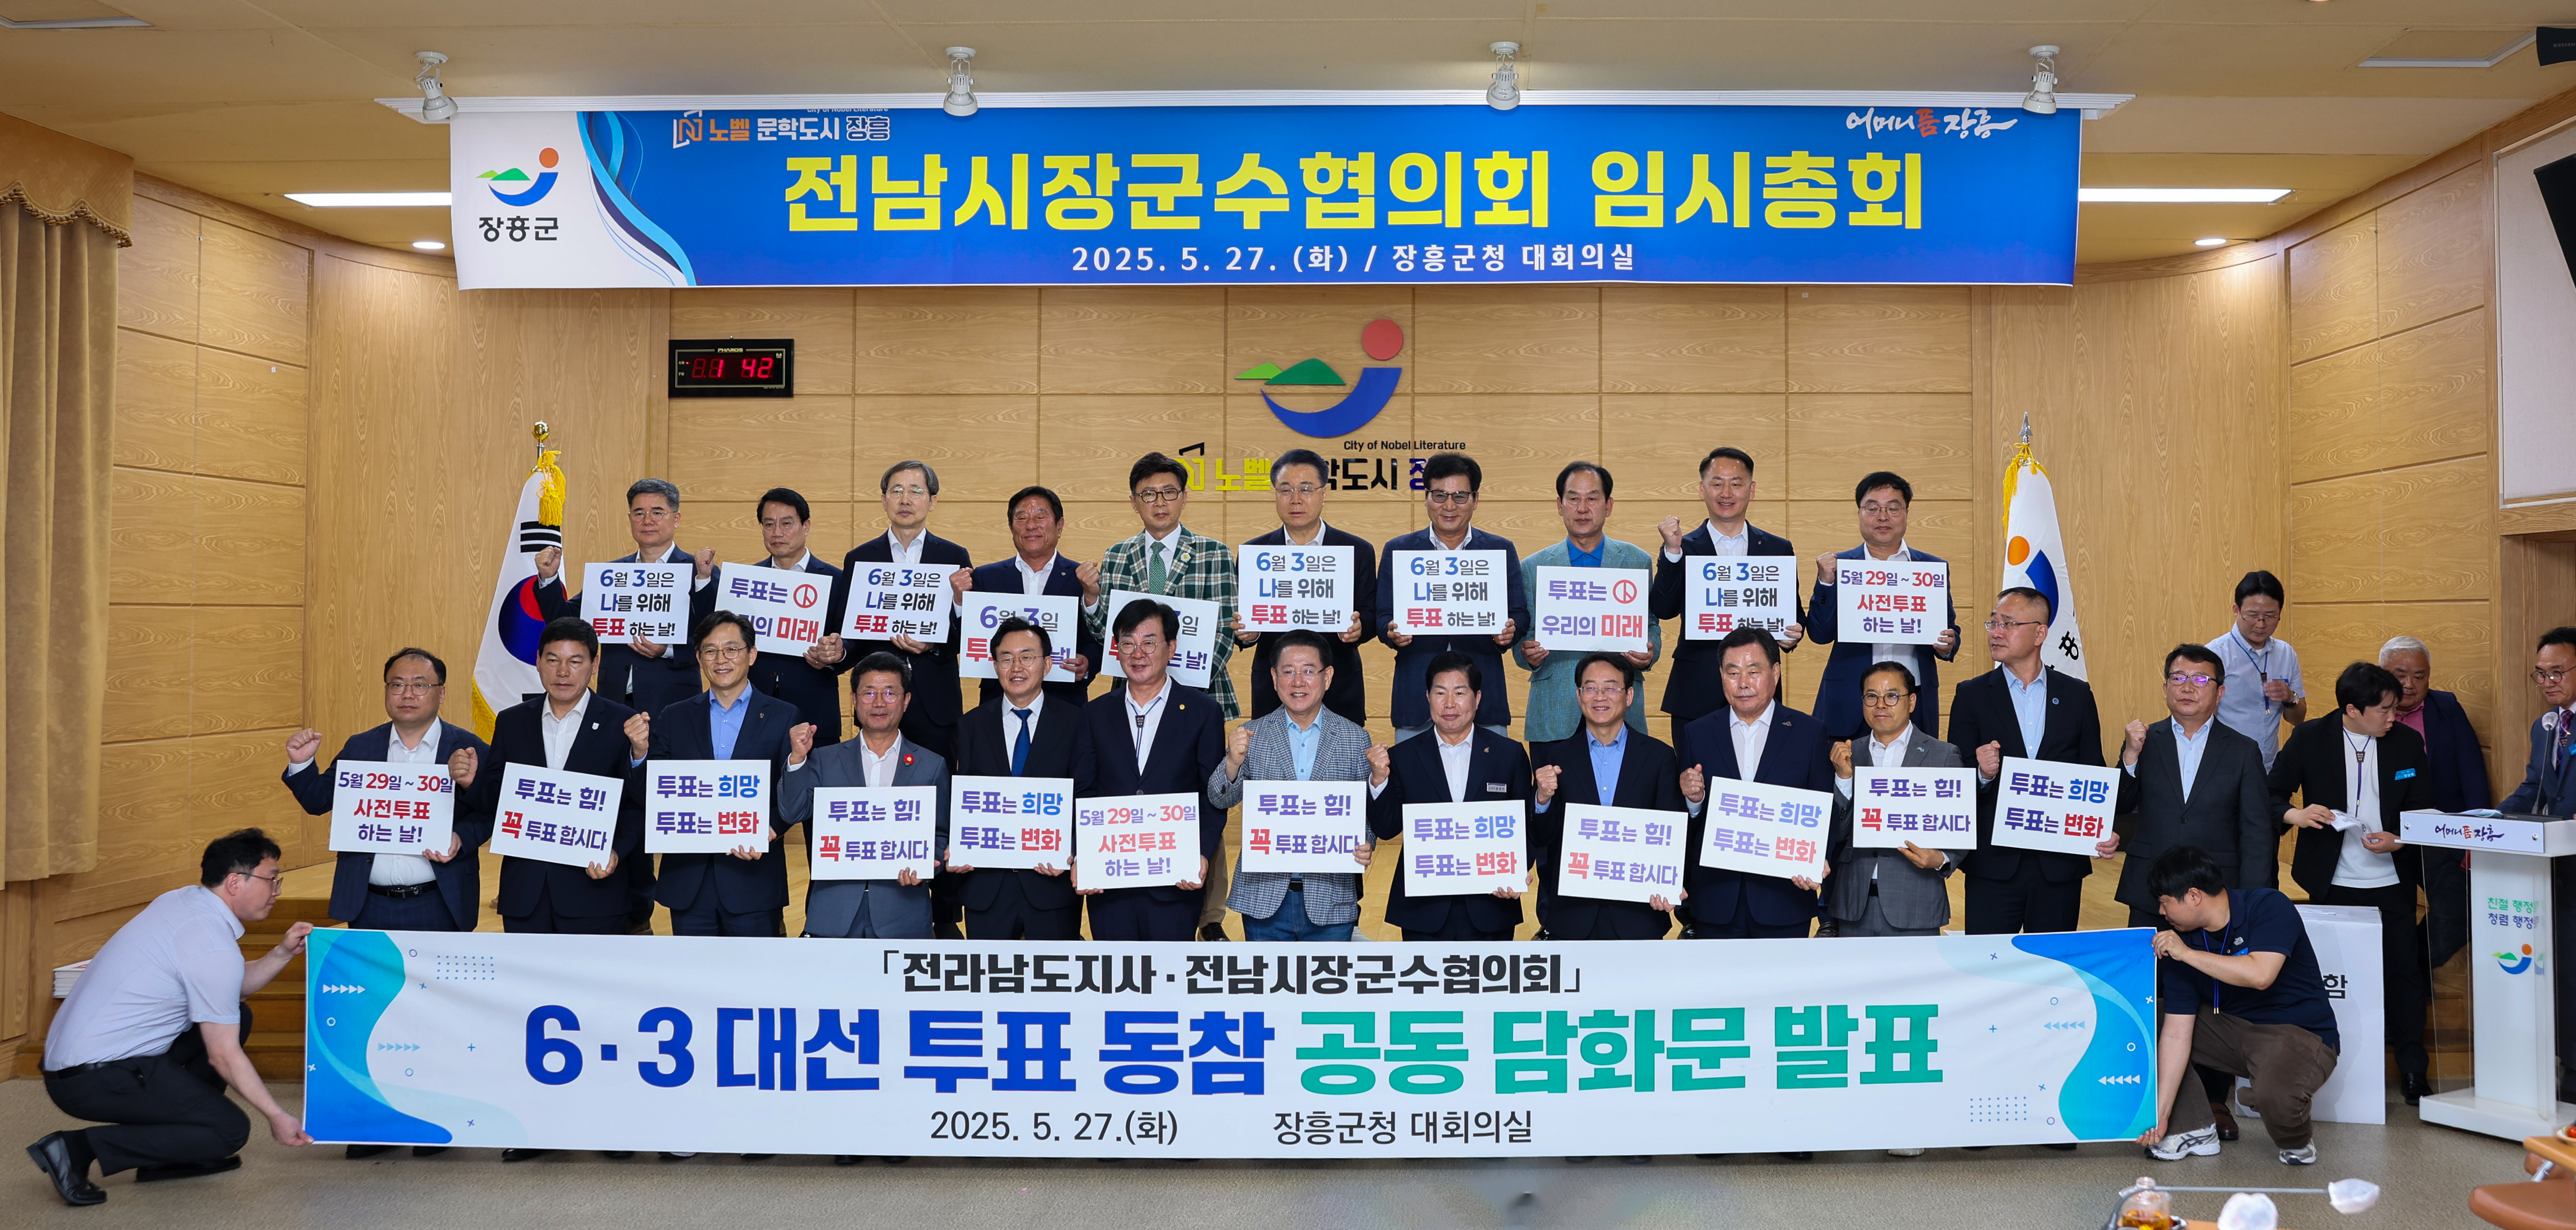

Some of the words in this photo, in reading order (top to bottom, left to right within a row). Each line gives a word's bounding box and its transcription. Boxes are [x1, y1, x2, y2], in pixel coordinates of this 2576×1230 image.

[710, 119, 750, 141] 노벨
[758, 118, 839, 140] 문학도시
[846, 116, 889, 141] 장흥
[784, 151, 1548, 231] 전남시장군수협의회
[1591, 150, 1922, 229] 임시총회
[479, 216, 558, 242] 장흥군
[1073, 247, 1165, 271] 2025.
[1182, 248, 1209, 271] 5.
[1226, 247, 1275, 271] 27.
[1294, 246, 1347, 272] (화)
[1364, 245, 1377, 272] /
[1393, 244, 1504, 272] 장흥군청
[1522, 244, 1633, 270] 대회의실
[1344, 440, 1364, 452] City
[1367, 440, 1378, 450] of
[1381, 440, 1410, 450] Nobel
[1414, 440, 1466, 450] Literature
[1216, 458, 1271, 491] 노벨
[1257, 552, 1285, 571] 6월
[1291, 553, 1336, 572] 3일은
[1411, 557, 1439, 575] 6월
[1445, 557, 1489, 575] 3일은
[1703, 563, 1730, 581] 6월
[1736, 563, 1779, 581] 3일은
[601, 570, 627, 587] 6월
[632, 570, 674, 587] 3일은
[868, 569, 895, 586] 6월
[899, 570, 940, 588] 3일은
[1259, 579, 1293, 598] 나를
[1298, 579, 1333, 598] 위해
[1841, 570, 1862, 585] 5월
[1866, 571, 1897, 586] 29일
[1913, 573, 1944, 587] 30일
[730, 578, 787, 603] 투표는
[866, 592, 898, 609] 나를
[901, 593, 936, 611] 위해
[1414, 582, 1447, 601] 나를
[1452, 582, 1487, 601] 위해
[1548, 580, 1607, 601] 투표는
[1706, 588, 1738, 607] 나를
[1743, 588, 1777, 607] 위해
[601, 593, 632, 612] 나를
[636, 594, 671, 612] 위해
[1858, 594, 1926, 612] 사전투표
[854, 615, 889, 632] 투표
[891, 620, 917, 635] 하는
[920, 621, 937, 635] 날!
[1024, 608, 1058, 632] 3일
[1251, 605, 1287, 625] 투표
[1292, 609, 1319, 624] 하는
[1323, 610, 1340, 624] 날!
[1407, 608, 1442, 627] 투표
[1447, 612, 1474, 627] 하는
[1478, 612, 1495, 626] 날!
[1698, 613, 1733, 632] 투표
[1767, 618, 1784, 632] 날!
[1863, 617, 1894, 633] 하는
[1901, 618, 1921, 633] 날!
[592, 618, 625, 637] 투표
[629, 622, 655, 637] 하는
[658, 623, 675, 636] 날!
[777, 617, 819, 643] 미래
[1542, 616, 1596, 636] 우리의
[1601, 615, 1642, 638] 미래
[1186, 651, 1207, 670] 날!
[338, 772, 363, 788] 5월
[366, 773, 401, 790] 29일
[417, 775, 452, 794] 30일
[657, 776, 713, 798] 투표는
[718, 775, 759, 798] 희망
[1870, 779, 1927, 797] 투표는
[1935, 779, 1961, 798] 힘!
[2010, 772, 2064, 799] 투표는
[2068, 779, 2109, 803] 희망
[515, 779, 572, 805] 투표는
[579, 787, 606, 811] 힘!
[961, 791, 1017, 814] 투표는
[1022, 792, 1063, 815] 희망
[1258, 795, 1317, 815] 투표는
[1324, 794, 1350, 816] 힘!
[354, 799, 430, 819] 사전투표
[828, 801, 886, 822] 투표는
[894, 799, 920, 821] 힘!
[1080, 810, 1104, 825] 5월
[1108, 808, 1143, 824] 29일
[1160, 805, 1196, 821] 30일
[1719, 793, 1774, 821] 투표는
[1779, 802, 1821, 828] 희망
[502, 811, 523, 838] 꼭
[525, 821, 557, 842] 투표
[560, 826, 607, 851] 합시다
[656, 812, 712, 834] 투표는
[718, 812, 759, 834] 변화
[1414, 818, 1470, 842] 투표는
[1475, 816, 1515, 838] 희망
[1861, 809, 1882, 831] 꼭
[1887, 814, 1918, 831] 투표
[1922, 814, 1970, 832] 합시다
[2005, 807, 2058, 833] 투표는
[2064, 814, 2104, 838] 변화
[359, 824, 392, 842] 하는
[399, 826, 422, 842] 날!
[960, 827, 1015, 850] 투표는
[1021, 828, 1061, 851] 변화
[1099, 832, 1176, 853] 사전투표
[1250, 829, 1271, 854] 꼭
[1276, 835, 1307, 854] 투표
[1311, 834, 1359, 855] 합시다
[1578, 818, 1637, 842] 투표는
[1645, 823, 1672, 846] 힘!
[820, 836, 840, 861] 꼭
[845, 842, 876, 861] 투표
[881, 841, 928, 860] 합시다
[1713, 828, 1769, 857] 투표는
[1775, 837, 1817, 863] 변화
[1105, 859, 1139, 876] 하는
[1148, 857, 1170, 875] 날!
[1415, 855, 1471, 878] 투표는
[1476, 852, 1517, 875] 변화
[1568, 852, 1589, 879] 꼭
[1594, 860, 1625, 881] 투표
[1629, 863, 1677, 885] 합시다
[2488, 897, 2508, 910] 친절
[2513, 900, 2533, 914] 행정
[2488, 913, 2508, 926] 청렴
[2513, 915, 2533, 929] 행정
[525, 1003, 695, 1088] 6·3
[716, 1007, 880, 1092] 대선
[904, 1010, 1077, 1094] 투표
[1098, 1010, 1275, 1096] 동참
[1296, 1010, 1469, 1096] 공동
[1492, 1007, 1751, 1094] 담화문
[1774, 1003, 1944, 1090] 발표
[931, 1111, 1018, 1140] 2025.
[1033, 1113, 1059, 1141] 5.
[1274, 1111, 1395, 1144] 장흥군청
[1412, 1111, 1531, 1144] 대회의실
